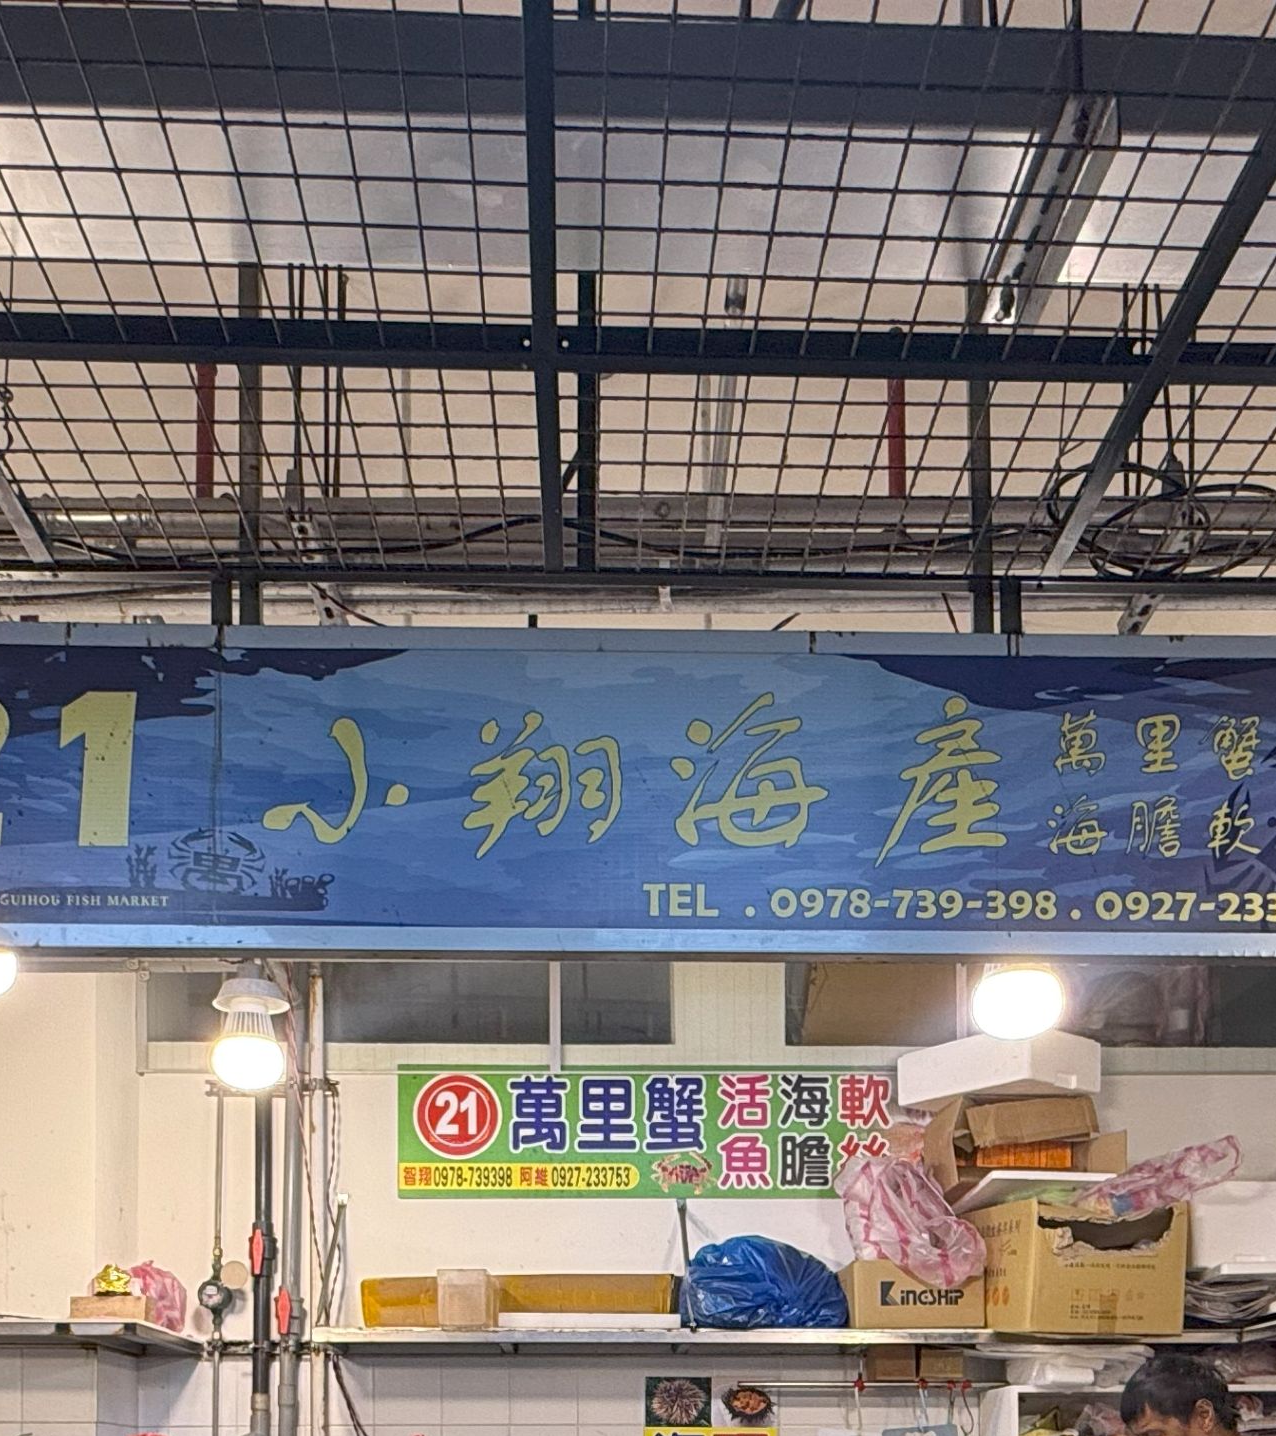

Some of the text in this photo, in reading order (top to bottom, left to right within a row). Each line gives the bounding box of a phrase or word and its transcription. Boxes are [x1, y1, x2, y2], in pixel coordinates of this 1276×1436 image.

[1054, 710, 1261, 780] 萬里蟹
[0, 894, 60, 906] GUIHOU
[67, 894, 101, 906] FISH
[107, 894, 169, 907] MARKET
[644, 883, 718, 918] TEL
[436, 1091, 478, 1135] 21
[509, 1076, 705, 1151] 萬里蟹
[721, 1075, 771, 1188] 活魚
[779, 1075, 831, 1188] 海膽
